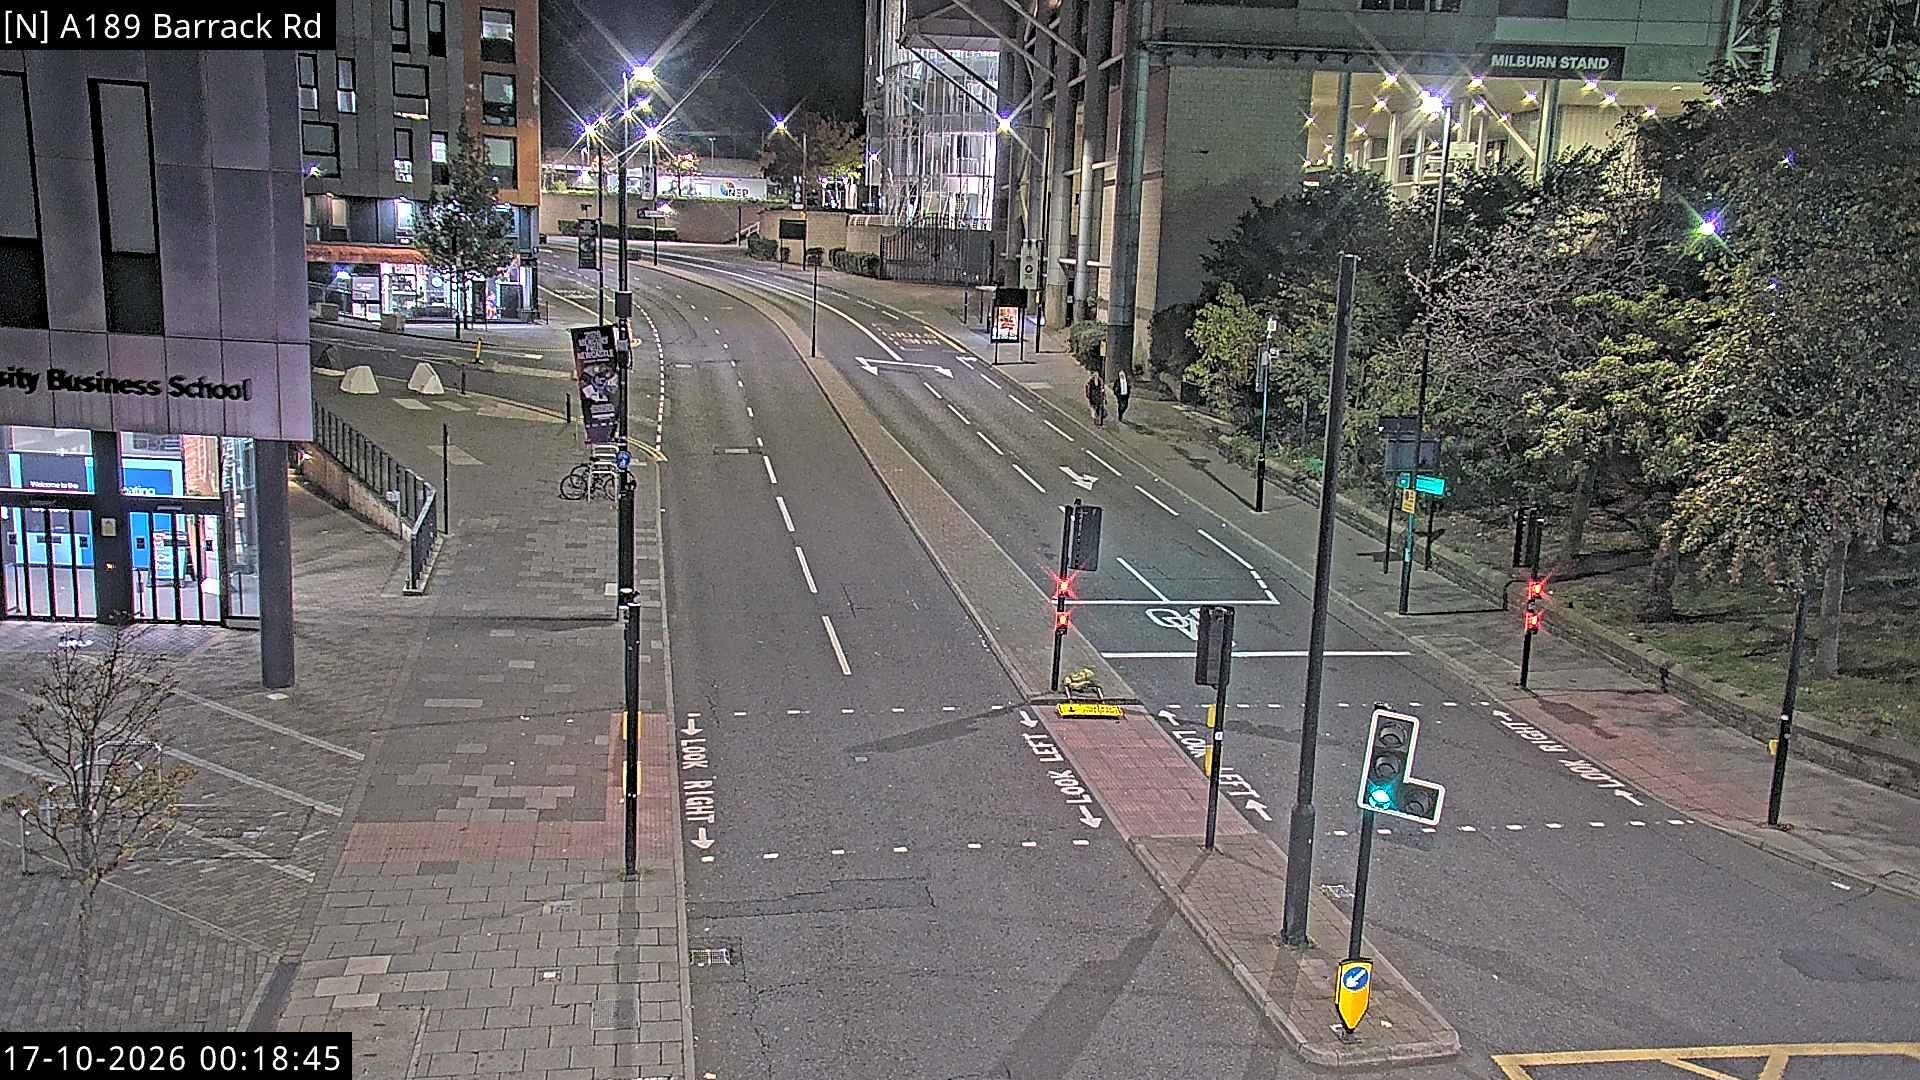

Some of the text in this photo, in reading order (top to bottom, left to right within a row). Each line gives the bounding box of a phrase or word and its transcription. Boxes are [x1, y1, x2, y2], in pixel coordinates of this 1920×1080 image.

[1491, 54, 1609, 70] MILBURN STAND
[47, 368, 162, 396] Business
[168, 375, 252, 401] School
[29, 480, 60, 489] Welcome
[1022, 733, 1092, 804] LOOK LEFT
[1500, 719, 1625, 788] LOOK RIGHT
[681, 738, 715, 823] LOOK RIGHT
